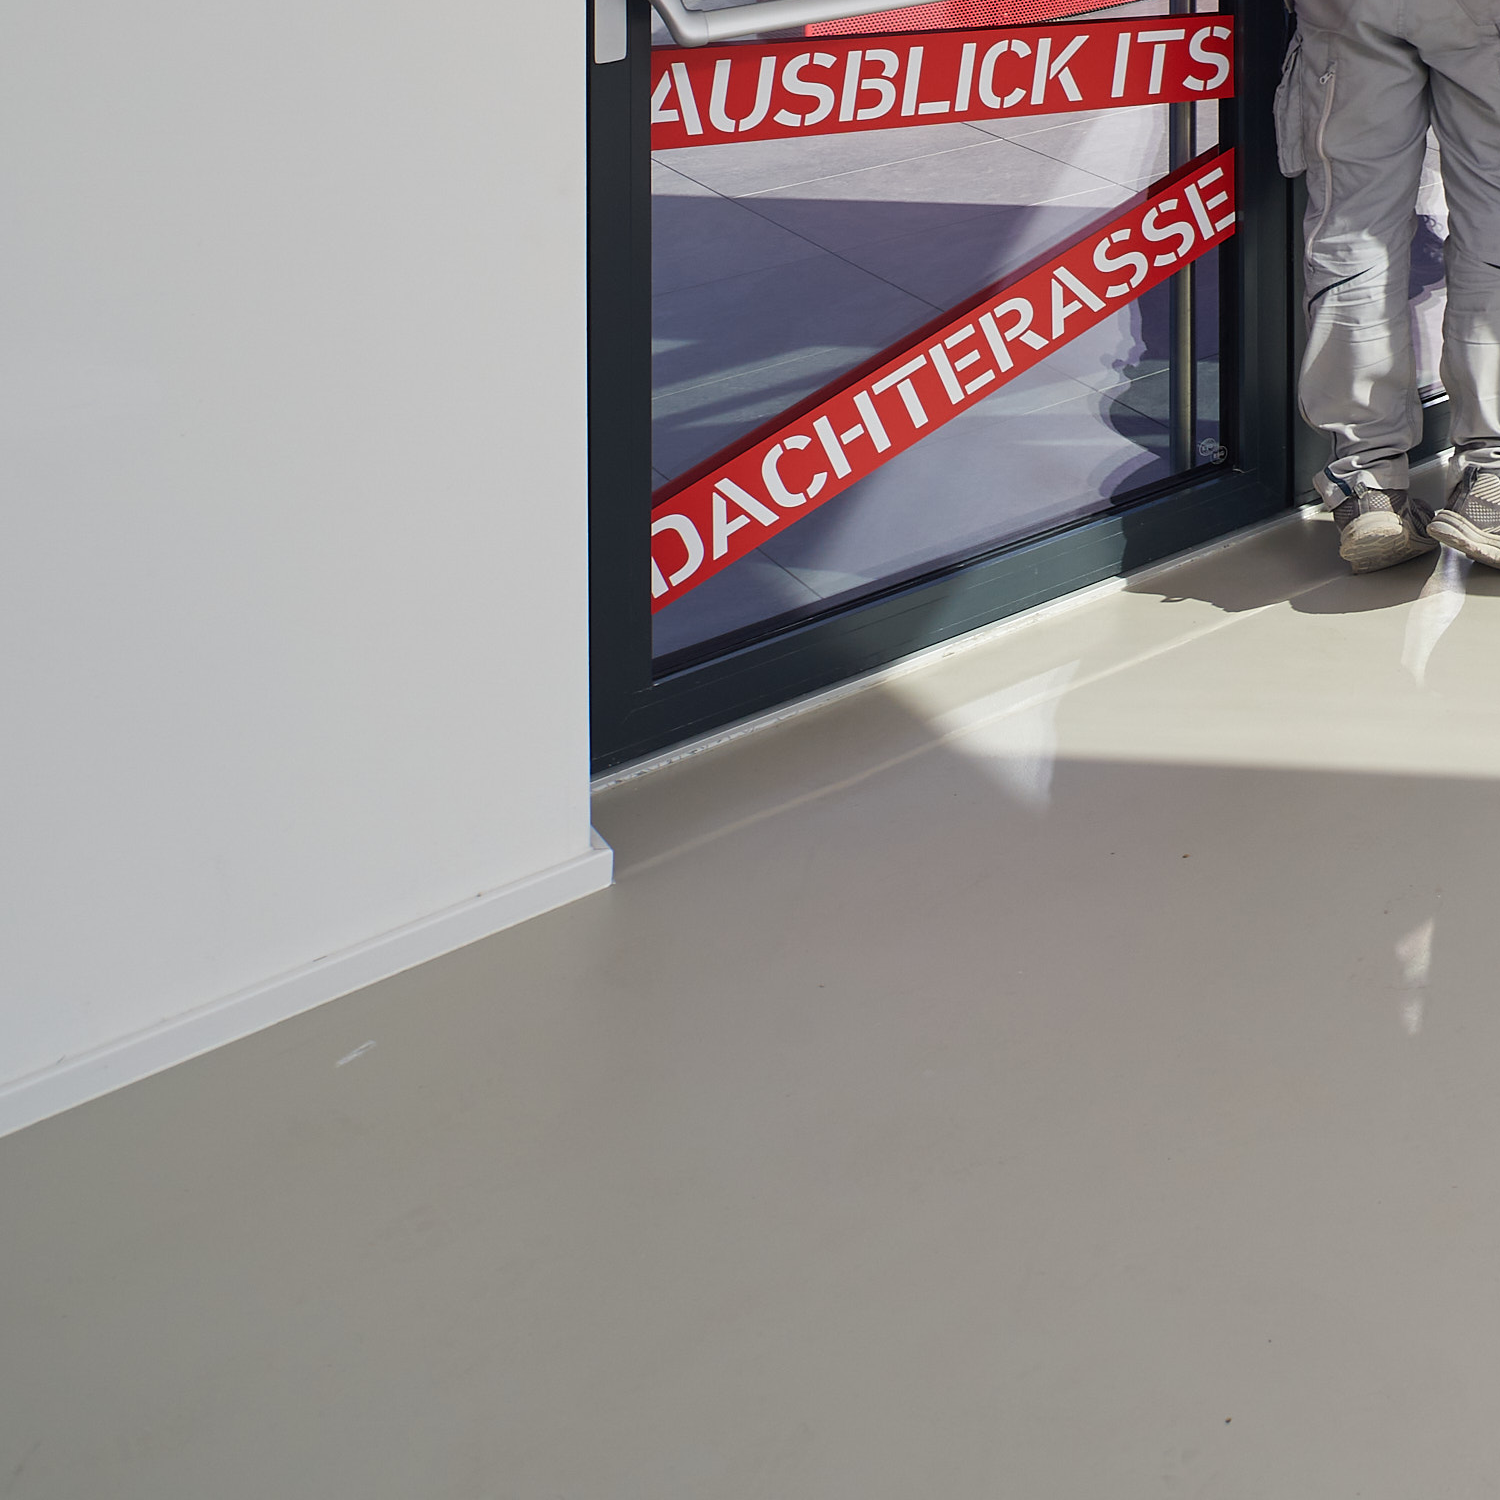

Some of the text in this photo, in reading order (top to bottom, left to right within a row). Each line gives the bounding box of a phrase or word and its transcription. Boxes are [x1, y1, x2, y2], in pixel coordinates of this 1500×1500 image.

[651, 26, 1232, 136] AUSBLICK ITS
[651, 166, 1236, 598] DACHTERASSE
